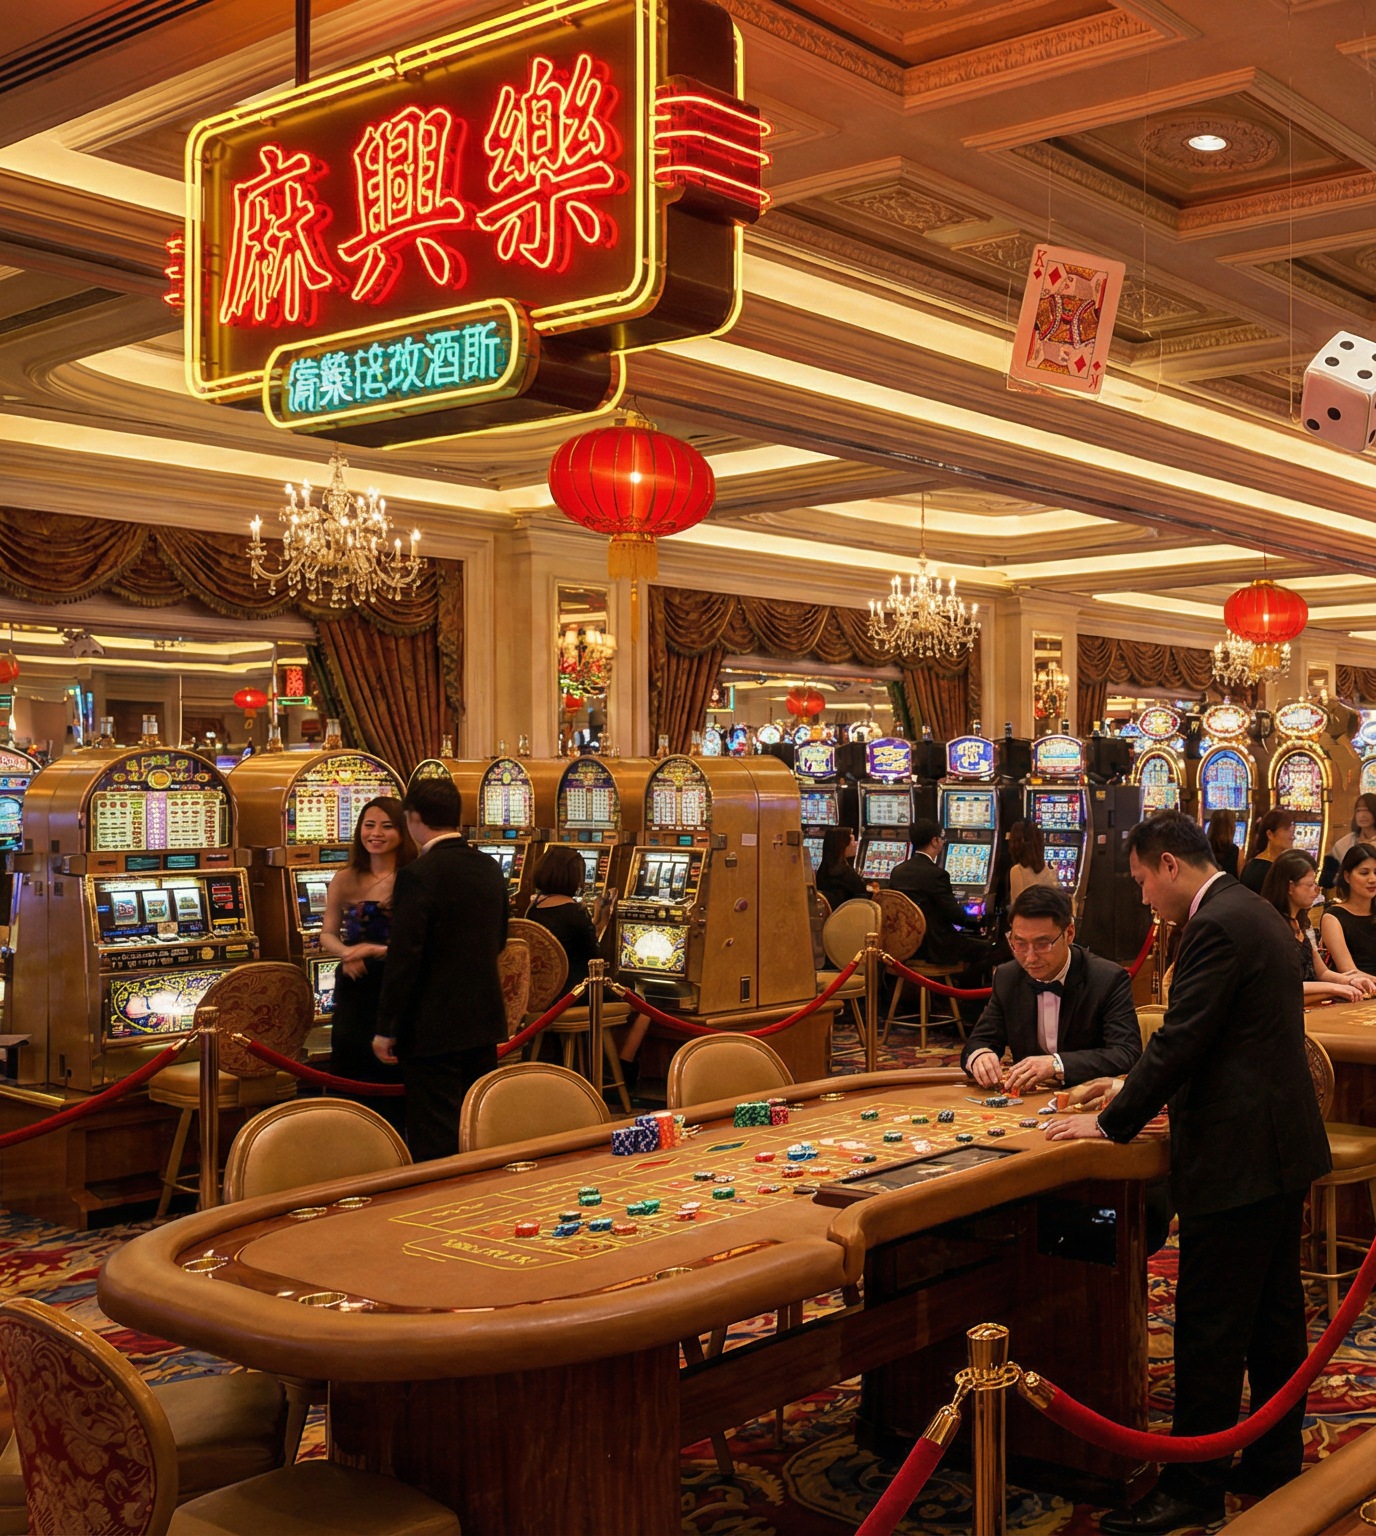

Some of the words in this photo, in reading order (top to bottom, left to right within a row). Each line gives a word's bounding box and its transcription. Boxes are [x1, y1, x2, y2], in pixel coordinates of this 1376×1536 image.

[218, 52, 616, 324] 麻興樂
[1034, 249, 1048, 268] K
